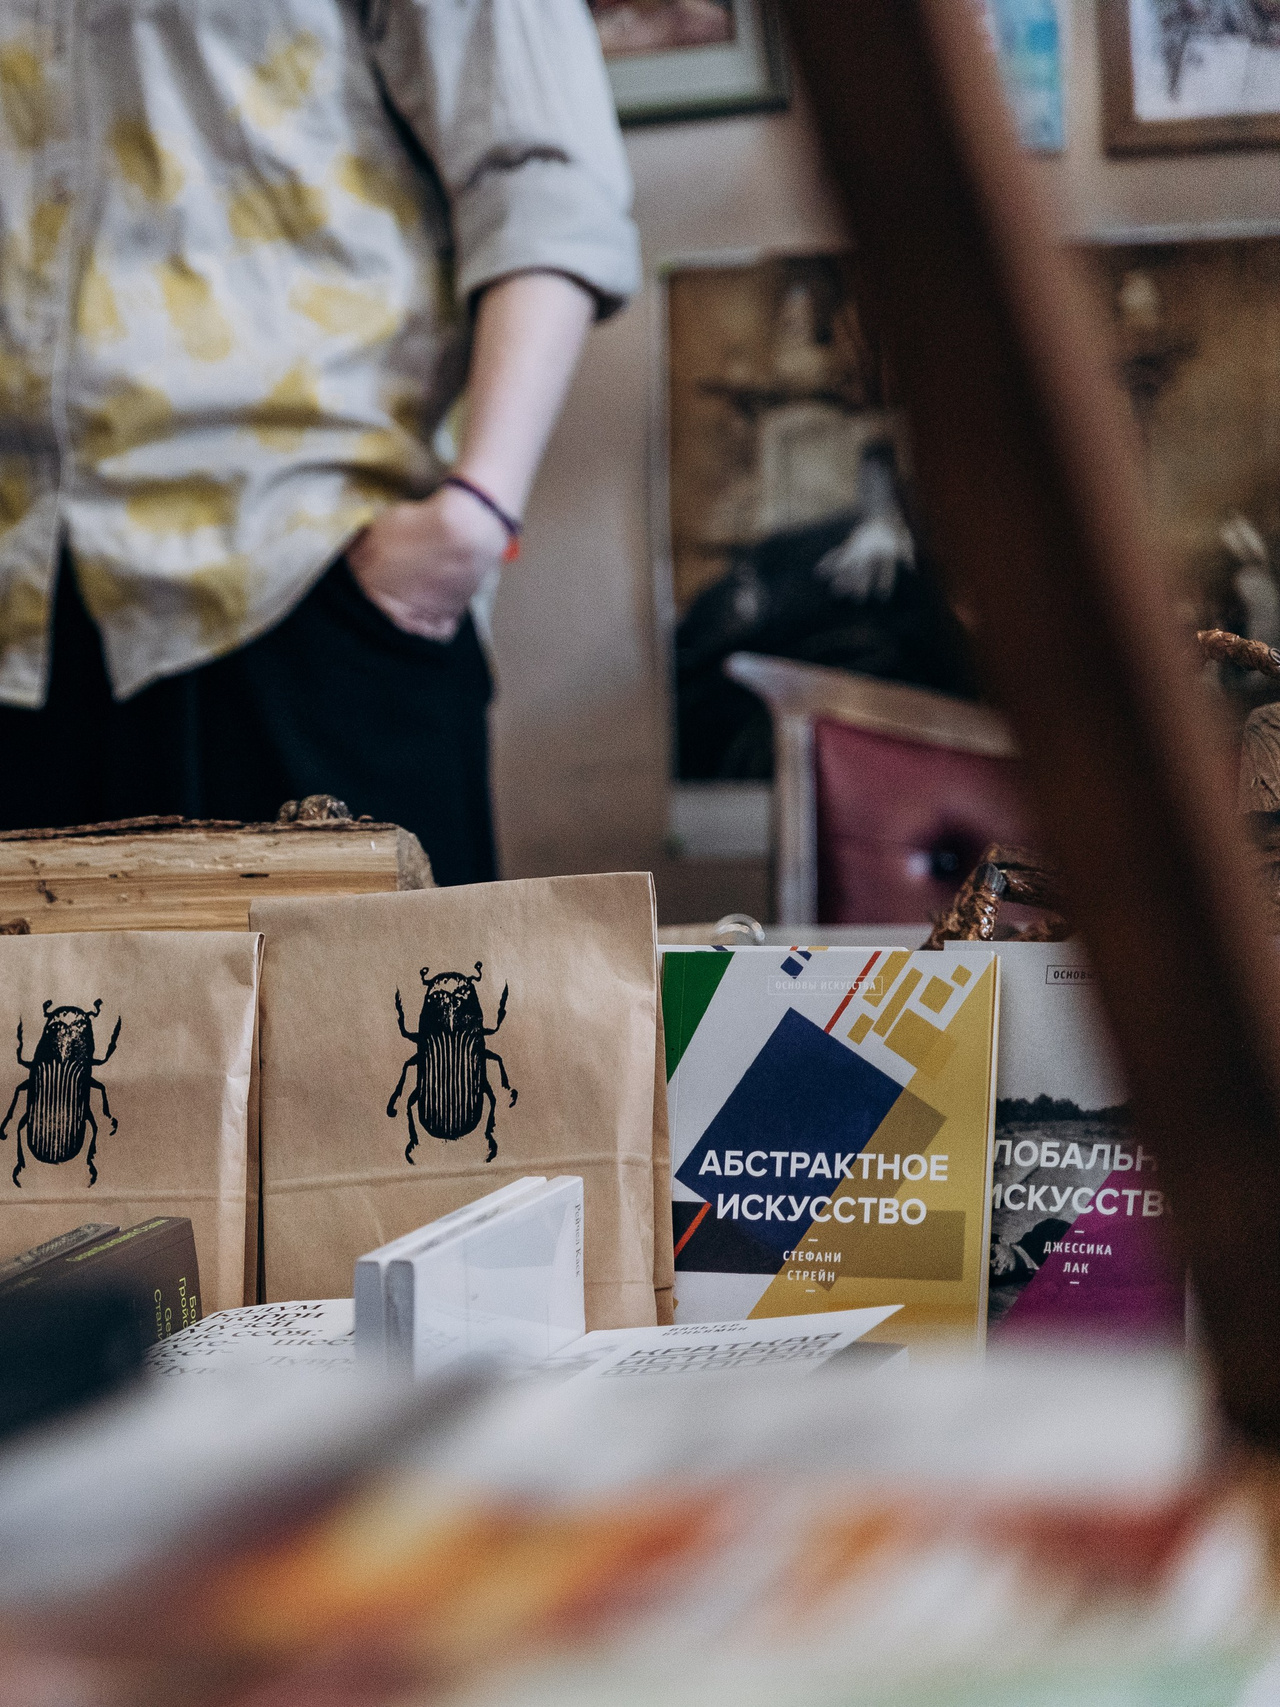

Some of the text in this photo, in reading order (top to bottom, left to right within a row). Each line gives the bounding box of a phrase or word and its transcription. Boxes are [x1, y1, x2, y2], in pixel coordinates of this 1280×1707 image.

[1053, 970, 1093, 980] ОСНОВ
[698, 1149, 949, 1181] АБСТРАКТНОЕ
[716, 1193, 928, 1226] ИСКУССТВО
[1043, 1241, 1112, 1256] ДЖЕССИКА
[783, 1250, 842, 1263] СТЕФАНИ
[787, 1268, 836, 1282] СТРЕЙН
[1063, 1262, 1090, 1274] ЛАК
[630, 1332, 843, 1357] КРАТКАЯ
[615, 1342, 829, 1366] ИСТОРИЯ
